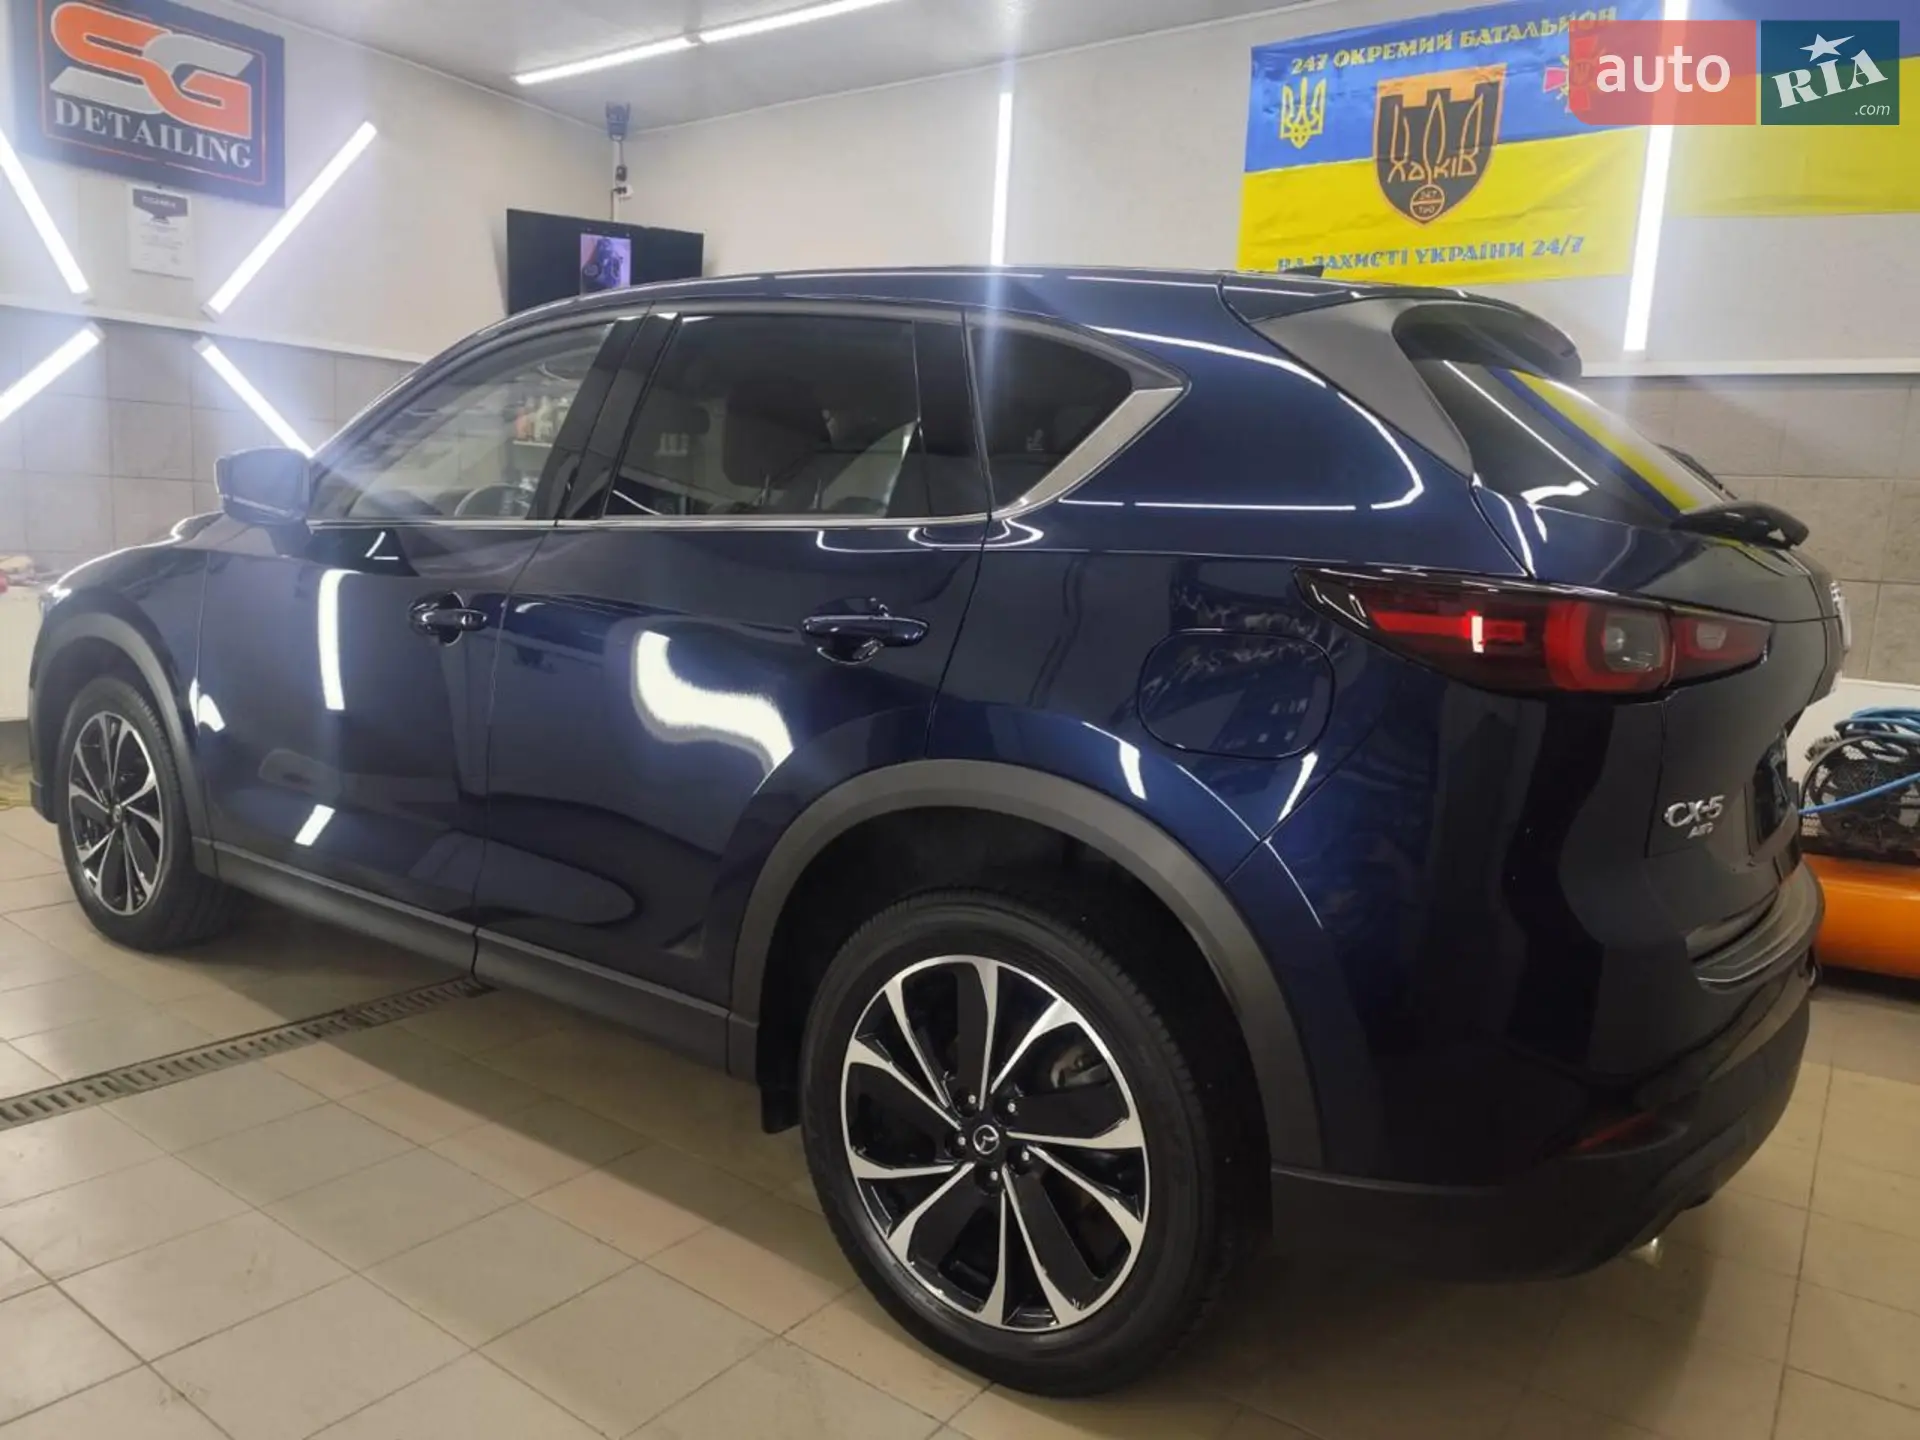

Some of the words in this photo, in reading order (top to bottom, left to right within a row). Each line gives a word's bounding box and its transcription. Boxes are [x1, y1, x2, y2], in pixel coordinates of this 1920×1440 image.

[51, 2, 252, 139] SG
[1291, 53, 1329, 75] 247
[1333, 29, 1453, 67] ОКРЕМИЙ
[54, 97, 253, 168] DETAILING
[1313, 248, 1410, 270] ЗАХИСТІ
[1415, 241, 1525, 265] УКРАЇНИ
[1532, 235, 1585, 256] 24/7
[1664, 795, 1725, 827] CX-5
